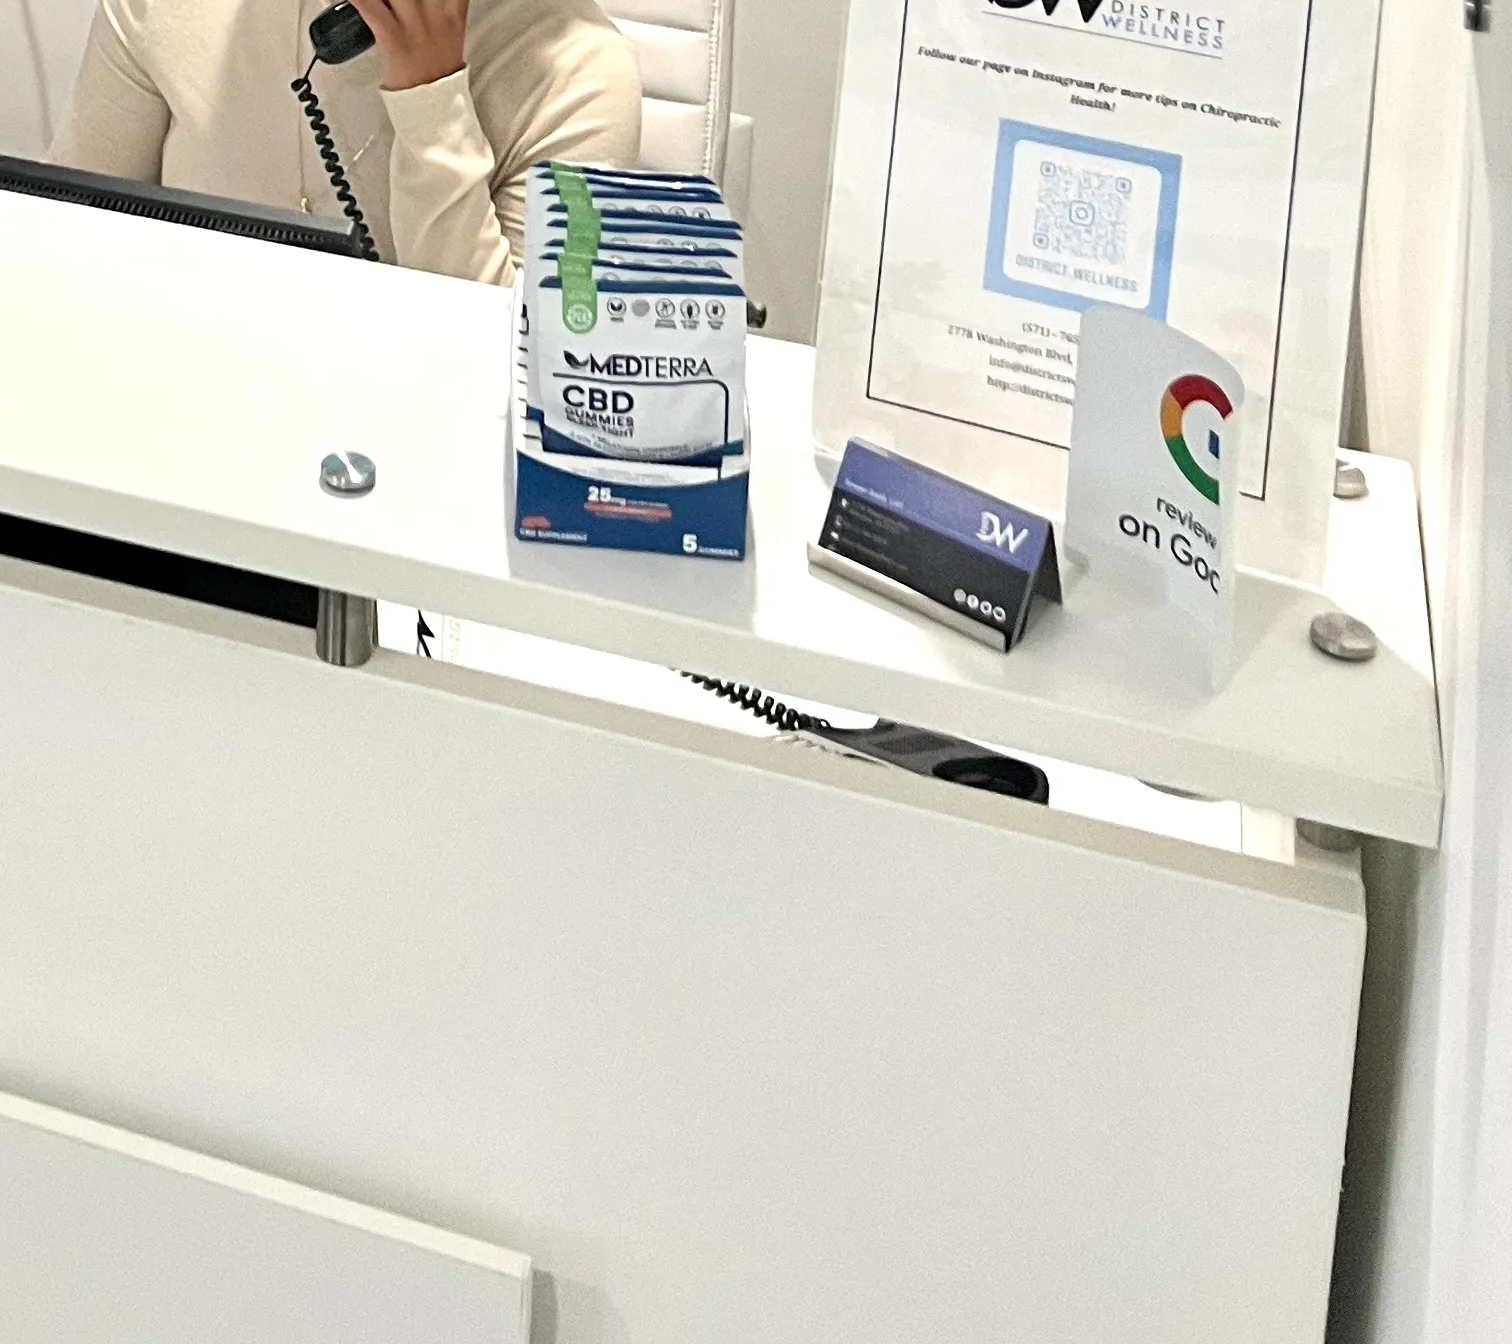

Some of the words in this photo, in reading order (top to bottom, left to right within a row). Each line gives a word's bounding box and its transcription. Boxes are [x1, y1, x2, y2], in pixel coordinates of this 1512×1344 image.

[1102, 13, 1224, 50] WELLNESS
[1111, 0, 1226, 33] DISTRICT
[918, 45, 957, 62] Follow
[959, 55, 981, 67] our
[982, 60, 1012, 74] page
[1014, 66, 1029, 77] on
[1031, 69, 1096, 90] Instagram
[1097, 81, 1117, 94] for
[1120, 88, 1153, 102] more
[1155, 93, 1178, 108] tips
[1181, 100, 1197, 112] on
[1200, 102, 1282, 128] Chiropractic
[1070, 93, 1116, 113] Health!
[977, 330, 1043, 357] Washington
[589, 352, 714, 379] MEDTERRA
[562, 384, 635, 414] CBD
[975, 511, 1029, 555] DW
[1118, 514, 1161, 550] on
[1156, 497, 1218, 552] review
[682, 532, 698, 553] 5
